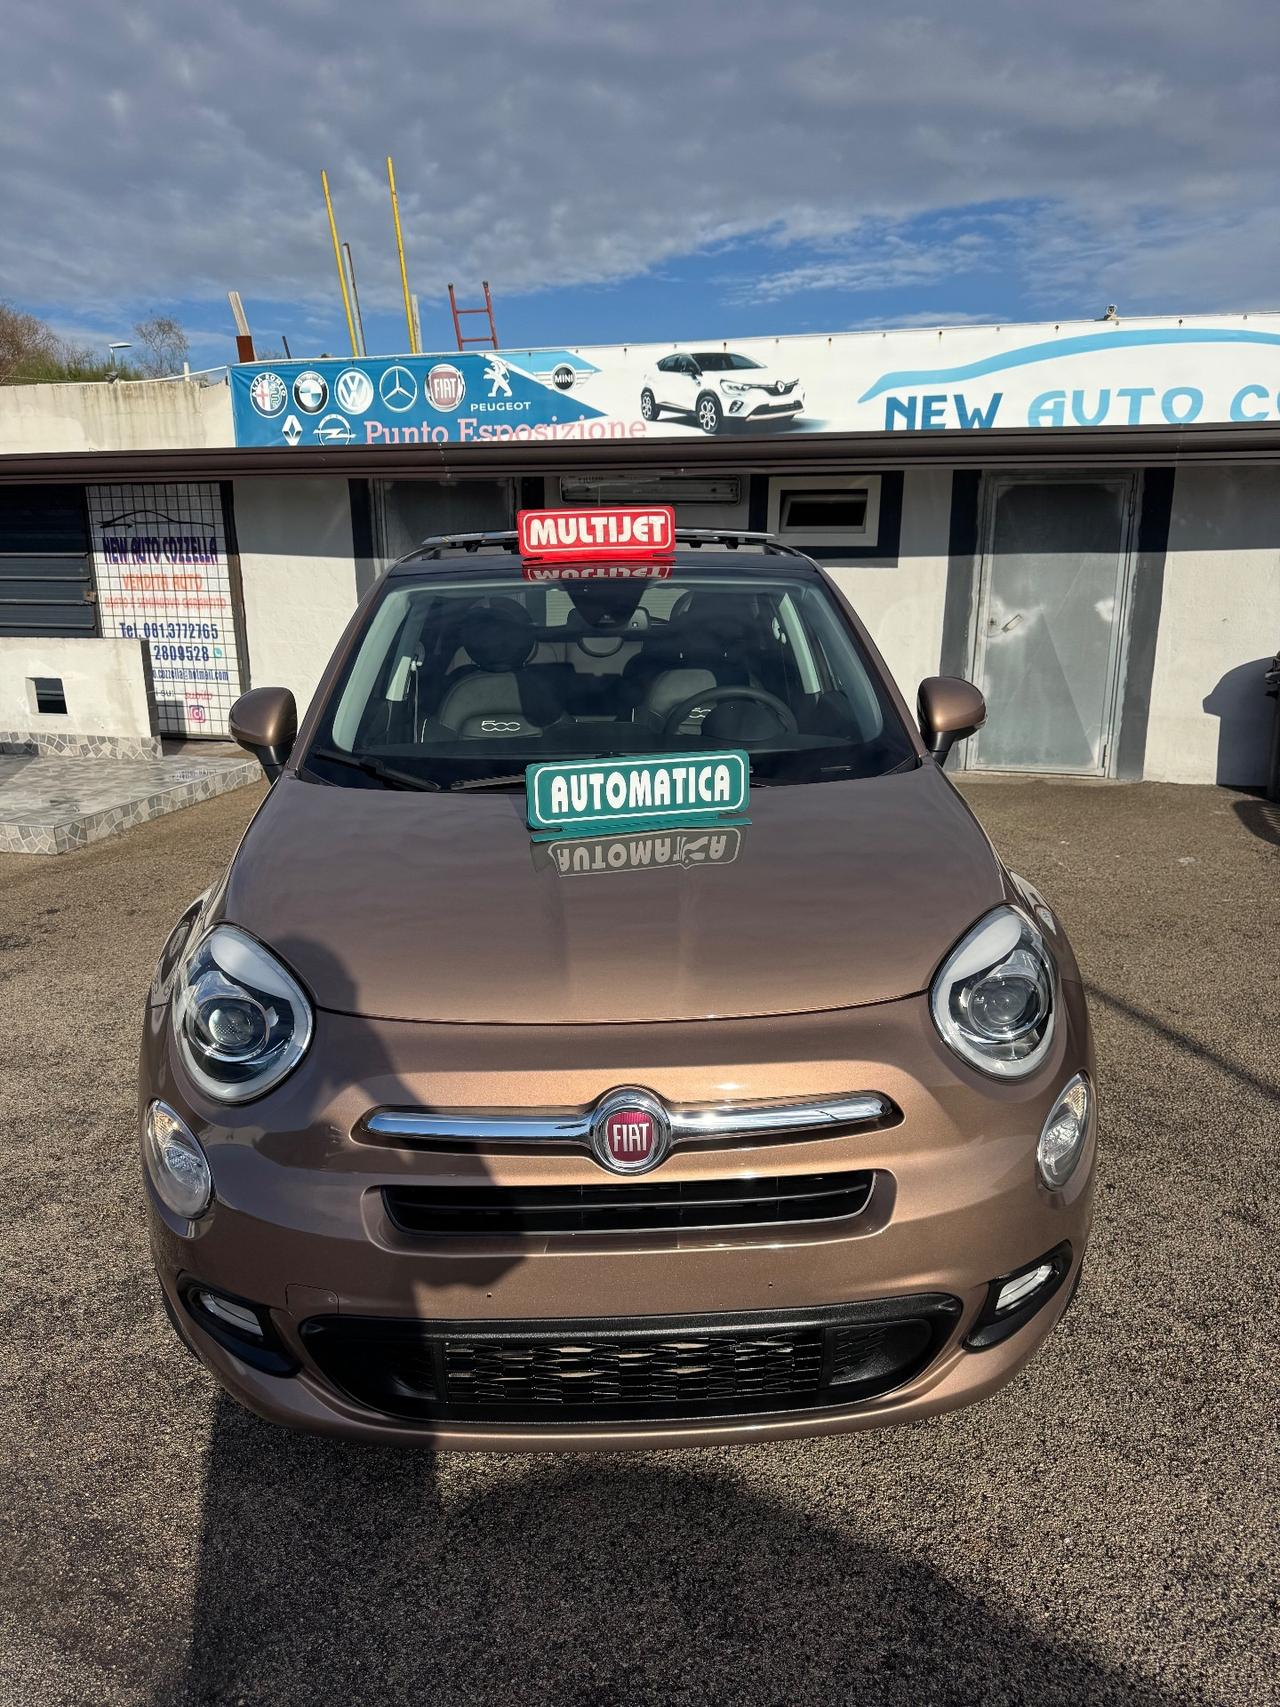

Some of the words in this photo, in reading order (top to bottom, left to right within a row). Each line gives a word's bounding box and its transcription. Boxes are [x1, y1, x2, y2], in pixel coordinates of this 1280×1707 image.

[433, 377, 457, 399] FIAT
[554, 373, 574, 384] MINI
[470, 401, 532, 412] PEUGEOT
[885, 392, 1004, 431] NEW
[1027, 386, 1204, 427] AUTO
[1229, 383, 1280, 421] C
[363, 420, 449, 444] Punto
[457, 414, 647, 442] Esposizione
[530, 515, 666, 546] MULTIJET
[102, 536, 129, 564] NEW
[130, 536, 161, 565] AUTO
[162, 536, 219, 566] COZZELLA
[122, 573, 169, 591] VENDITA
[172, 573, 203, 591] AUTO
[119, 622, 142, 638] Tel.
[143, 622, 219, 639] 081.3772765
[153, 645, 210, 661] 2809528
[480, 719, 522, 732] 500
[551, 764, 731, 814] AUTOMATICA
[612, 1122, 650, 1152] FIAT
